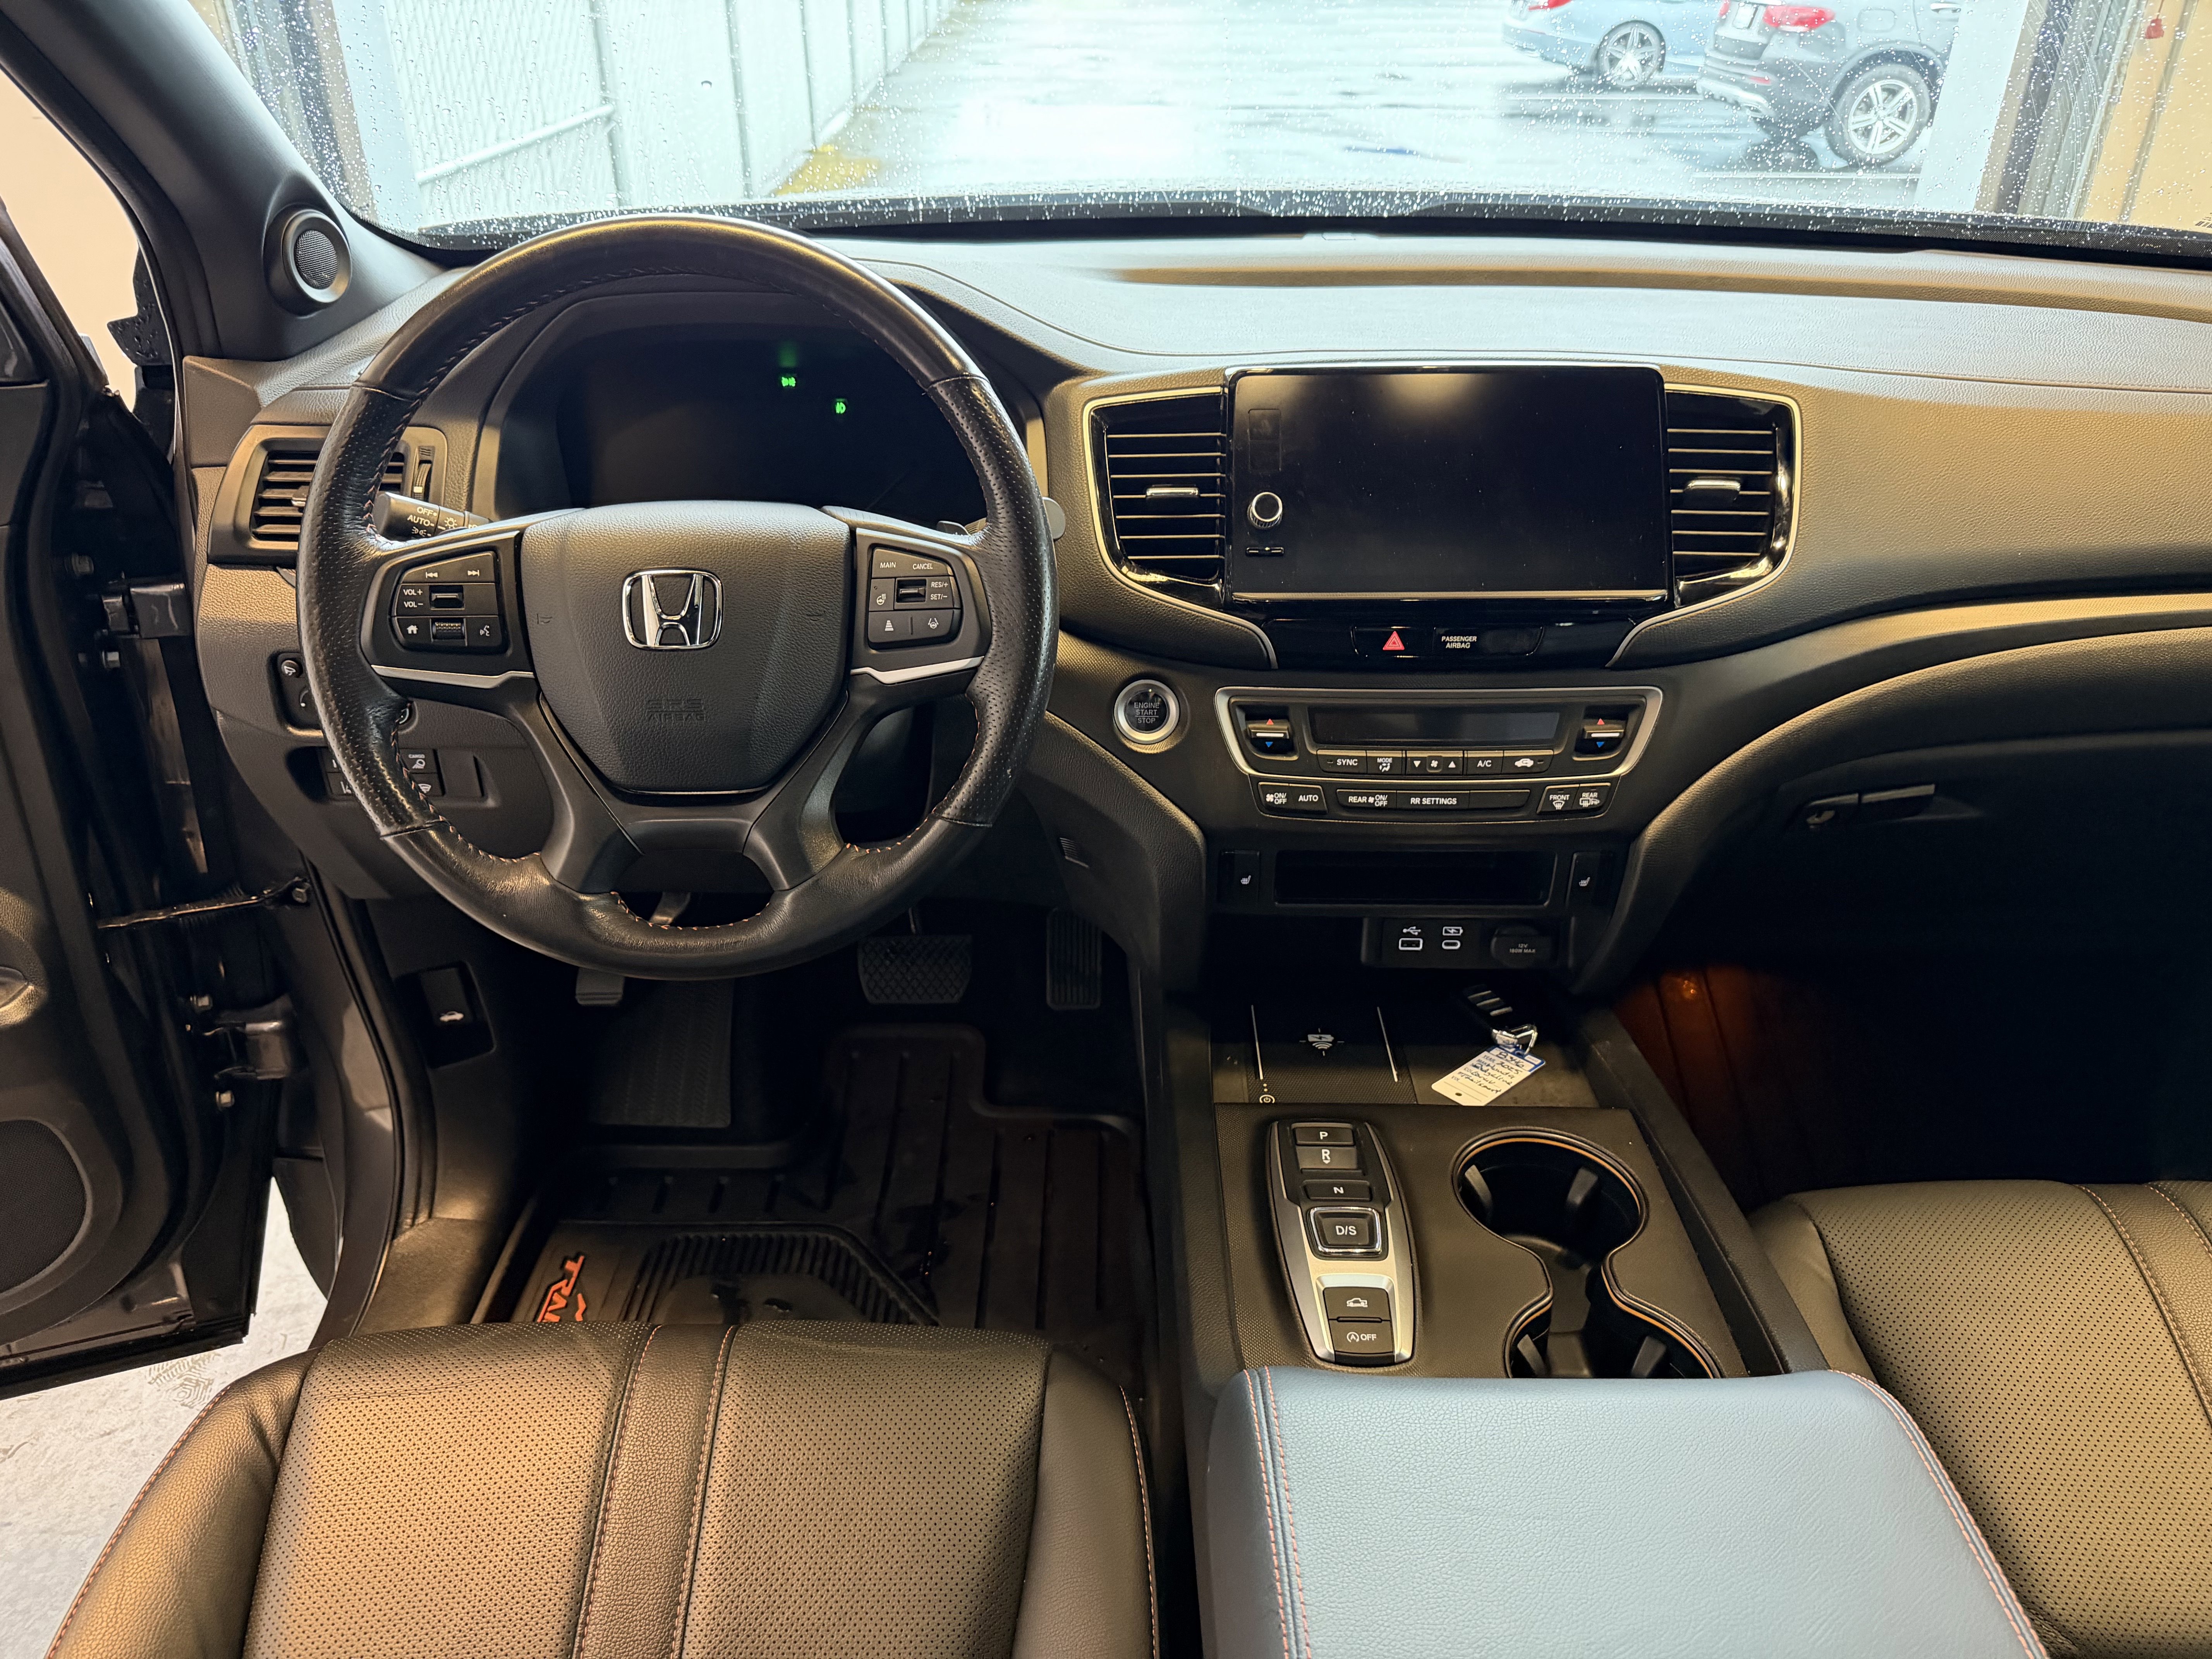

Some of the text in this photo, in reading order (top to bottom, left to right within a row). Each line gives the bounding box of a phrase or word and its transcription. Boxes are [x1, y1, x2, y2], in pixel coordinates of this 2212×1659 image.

[417, 506, 433, 516] OFF
[407, 514, 430, 527] AUTO
[1319, 1132, 1328, 1140] P
[1322, 1149, 1331, 1159] R
[1335, 1225, 1357, 1235] D/S
